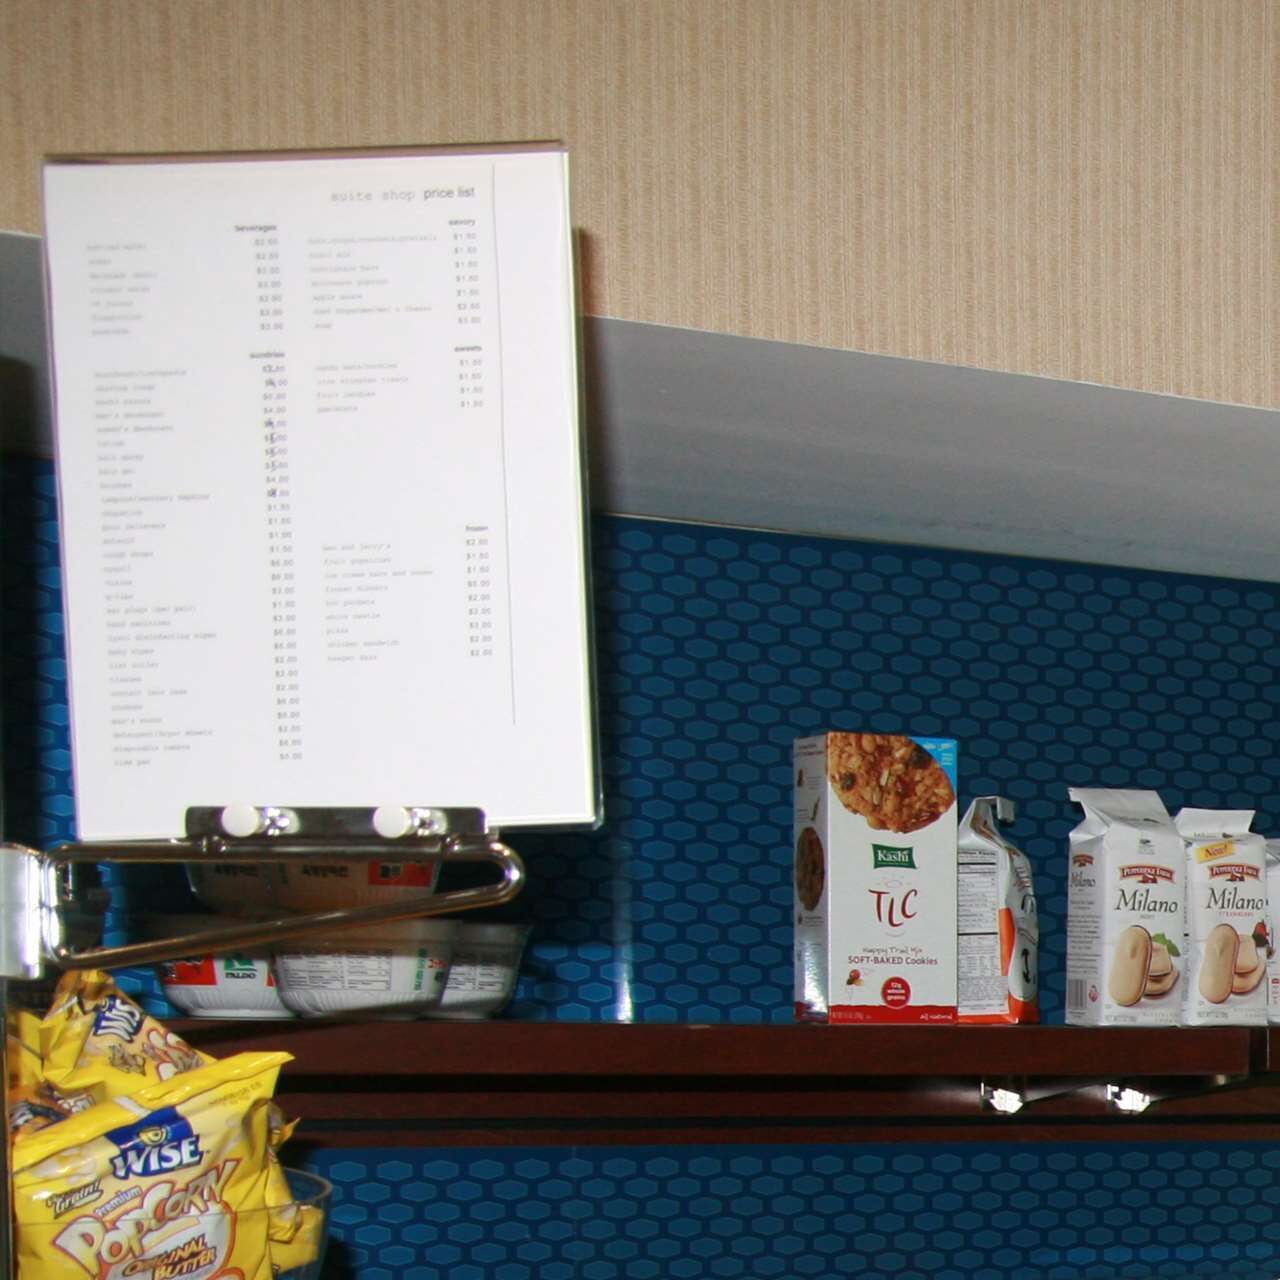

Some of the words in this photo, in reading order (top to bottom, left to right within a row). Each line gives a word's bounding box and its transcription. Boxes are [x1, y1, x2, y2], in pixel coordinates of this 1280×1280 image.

[423, 187, 452, 201] price
[458, 186, 476, 198] list
[877, 849, 909, 863] Kashi
[868, 888, 918, 928] TLC
[1114, 888, 1179, 914] Milano
[1205, 886, 1264, 911] Milano
[848, 956, 903, 965] SOFT-BAKED
[905, 957, 938, 966] Cookies
[111, 1134, 200, 1181] WISE
